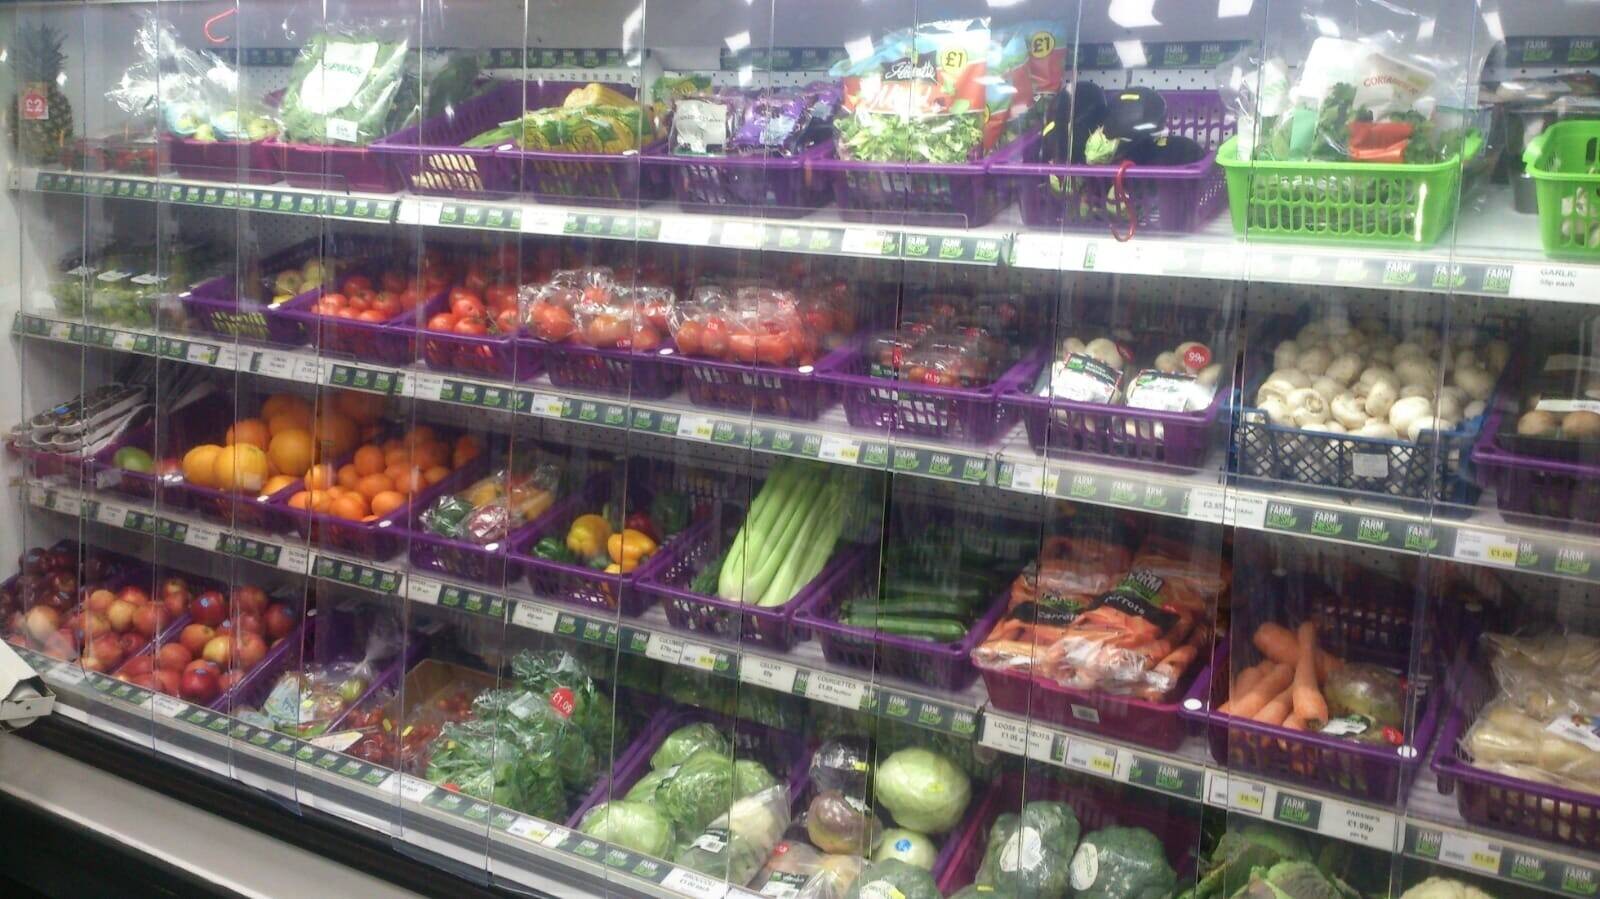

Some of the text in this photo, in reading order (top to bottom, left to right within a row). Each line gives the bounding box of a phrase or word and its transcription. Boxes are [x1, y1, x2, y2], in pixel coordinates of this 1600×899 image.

[1033, 37, 1050, 53] £1
[945, 53, 963, 68] £1
[25, 98, 44, 113] £2
[1486, 267, 1512, 279] FARM
[1188, 351, 1205, 362] 99p
[1269, 504, 1292, 516] FARM
[1314, 511, 1337, 523] FARM
[1360, 519, 1384, 530] FARM
[1558, 548, 1584, 561] FARM
[1158, 765, 1179, 778] FARM
[1282, 797, 1305, 810] FARM
[1418, 831, 1442, 845] FARM
[1514, 855, 1540, 869] FARM
[1564, 867, 1592, 882] FARM
